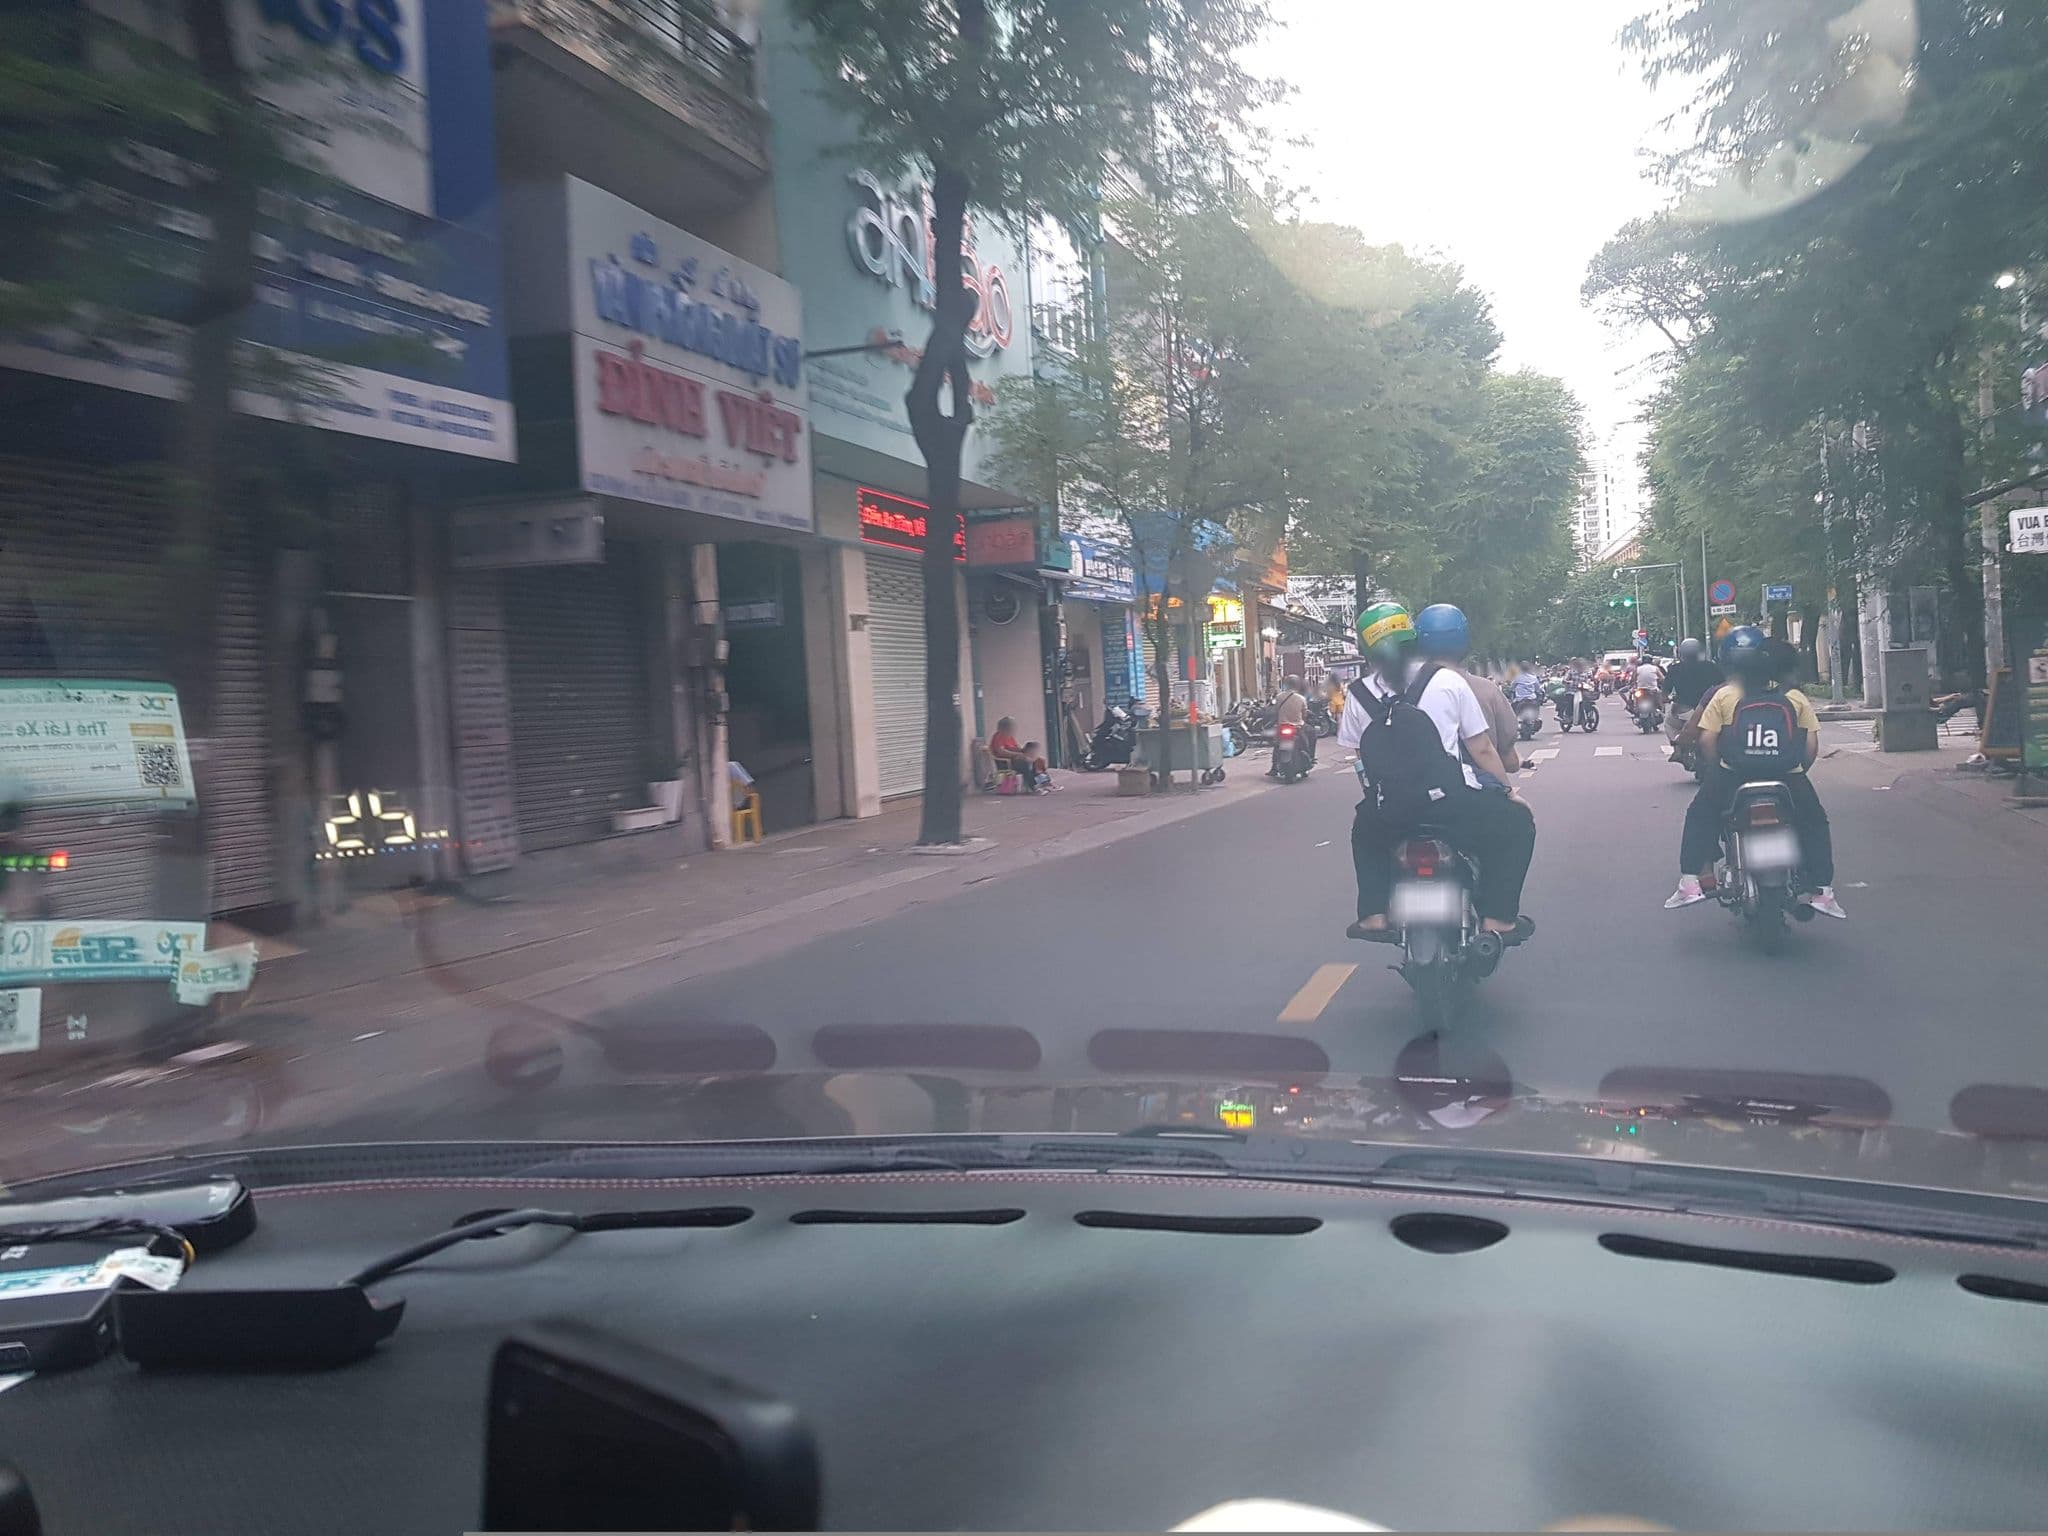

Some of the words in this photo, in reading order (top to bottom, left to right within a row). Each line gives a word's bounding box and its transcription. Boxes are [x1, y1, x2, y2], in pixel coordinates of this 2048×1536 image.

[715, 390, 802, 468] VIỆT
[2017, 515, 2041, 530] VUA
[1747, 723, 1778, 748] ila
[324, 791, 417, 849] 25
